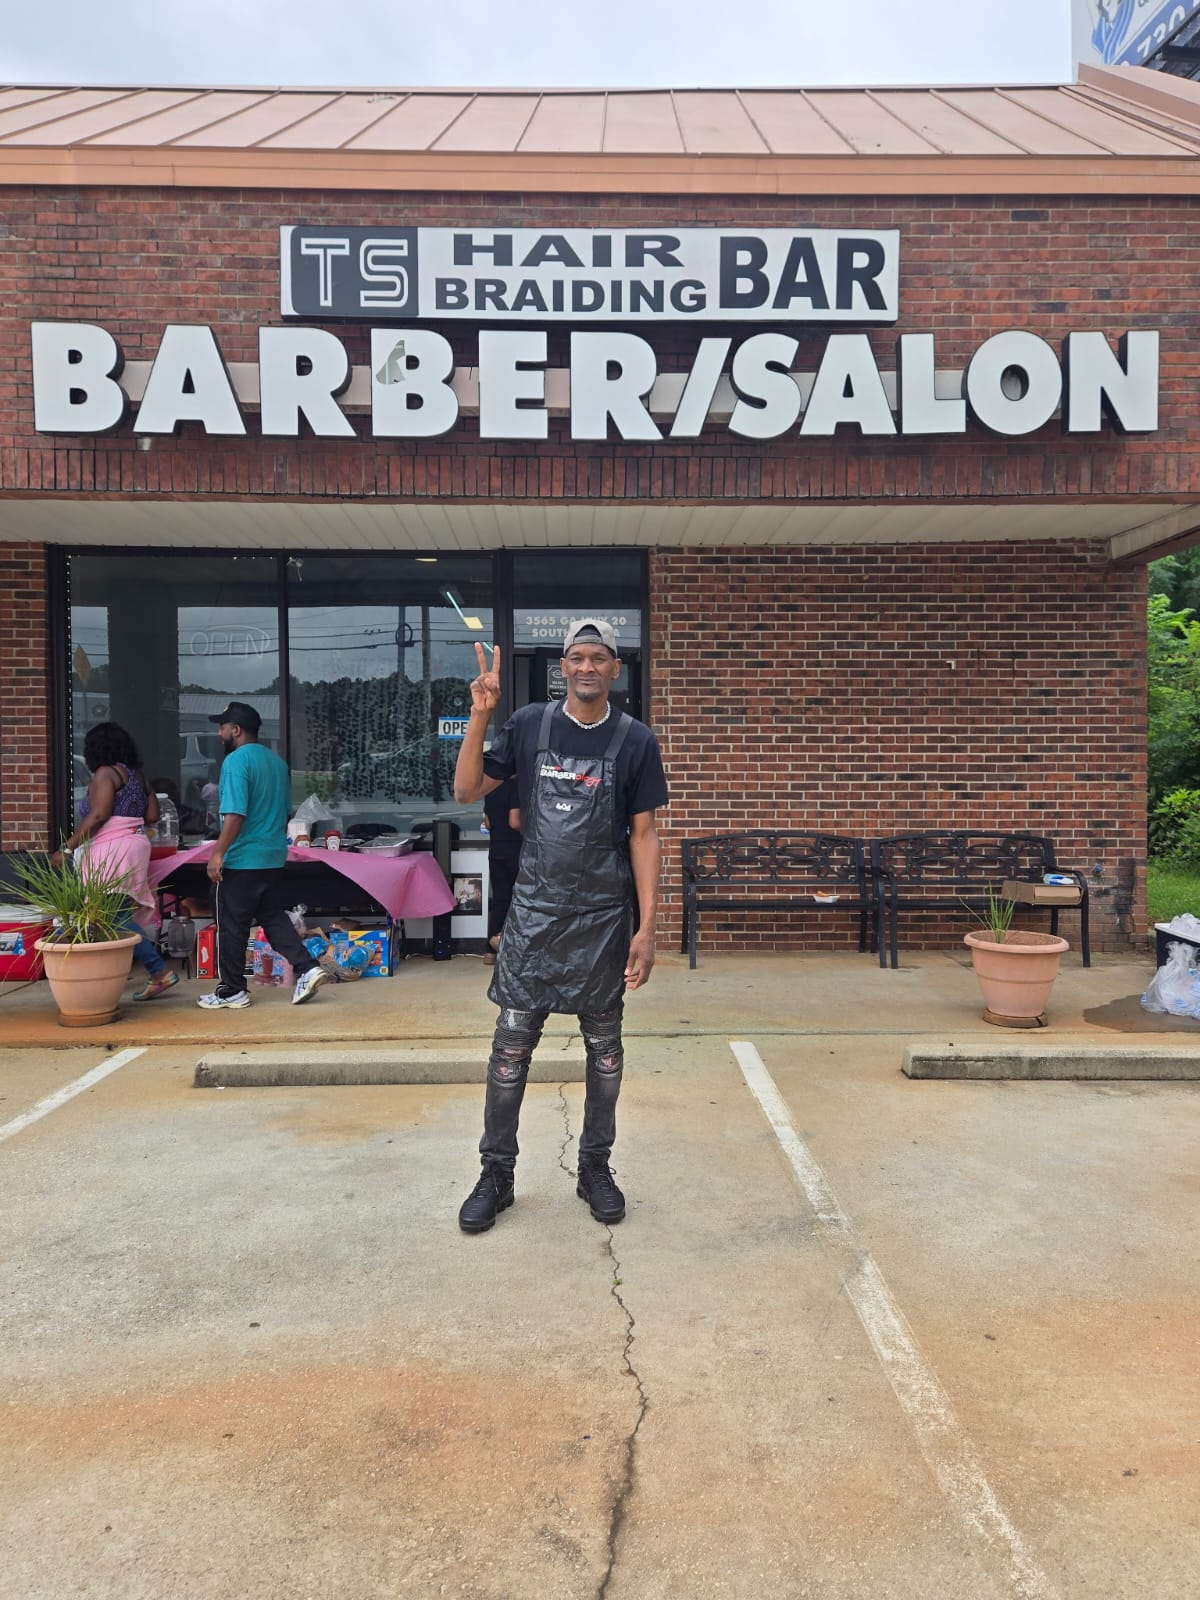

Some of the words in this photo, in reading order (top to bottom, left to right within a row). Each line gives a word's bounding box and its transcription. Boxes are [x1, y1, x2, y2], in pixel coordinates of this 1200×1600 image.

[453, 233, 685, 267] HAIR
[300, 237, 409, 308] TS
[719, 235, 888, 312] BAR
[434, 278, 707, 314] BRAIDING
[31, 321, 1160, 441] BARBER/SALON
[525, 616, 556, 625] 3565
[611, 616, 627, 625] 20
[191, 631, 265, 659] OPEN
[442, 721, 468, 735] OPE
